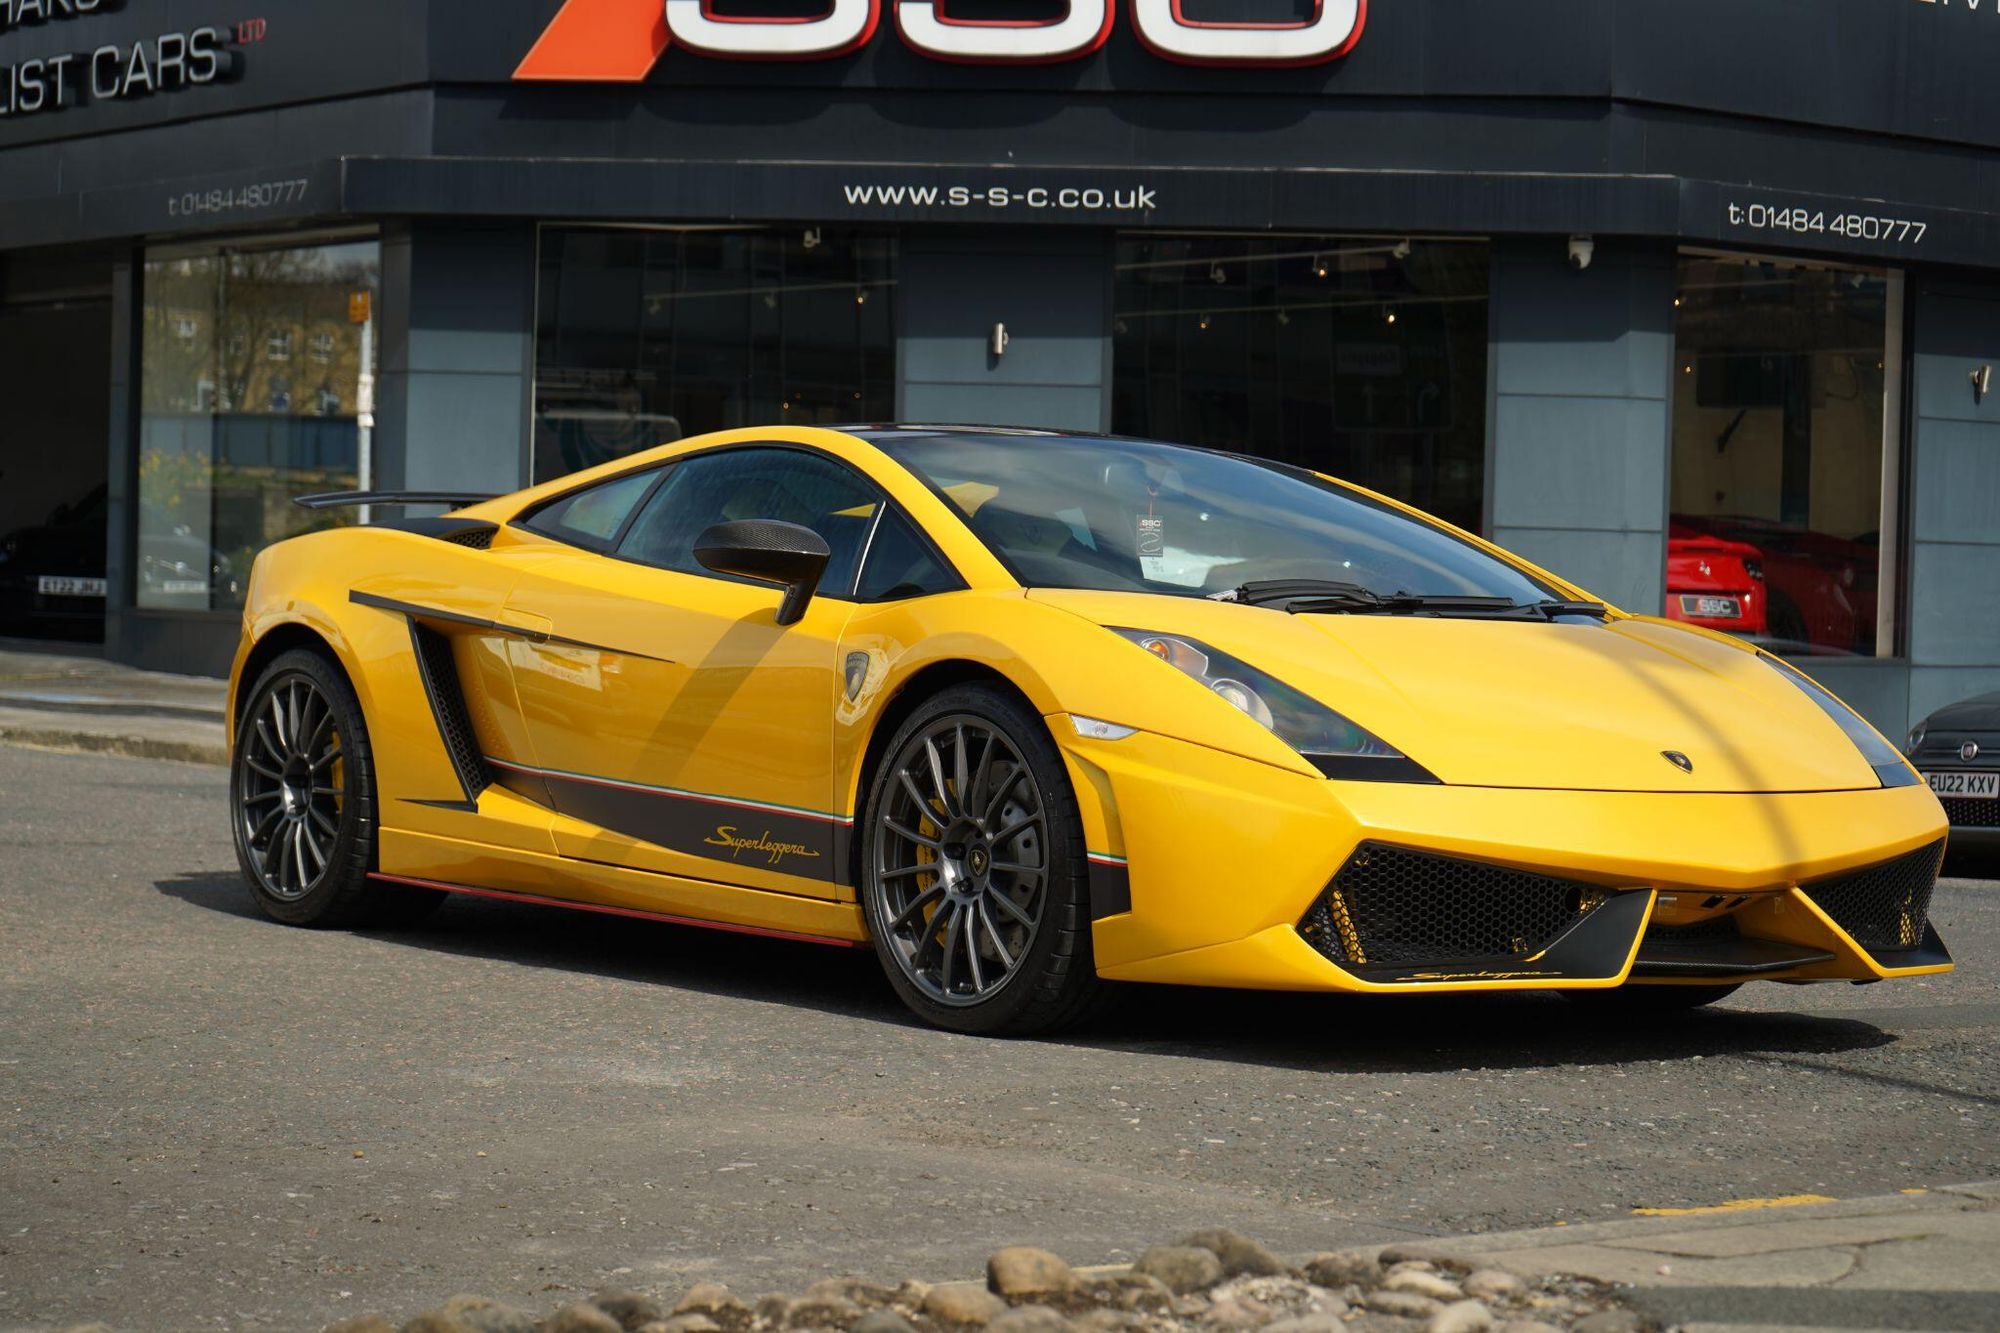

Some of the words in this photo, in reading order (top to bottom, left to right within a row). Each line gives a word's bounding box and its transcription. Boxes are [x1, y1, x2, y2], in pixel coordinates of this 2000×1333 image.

[92, 27, 217, 98] CARS
[237, 18, 267, 44] LTD
[236, 178, 308, 208] 480777
[843, 185, 1157, 209] www.s-s-c.co.uk
[1749, 203, 1825, 234] 01484
[1829, 213, 1927, 244] 480777
[1929, 774, 1964, 793] EU22
[1967, 775, 1996, 794] KXV
[703, 825, 820, 864] Superleggera
